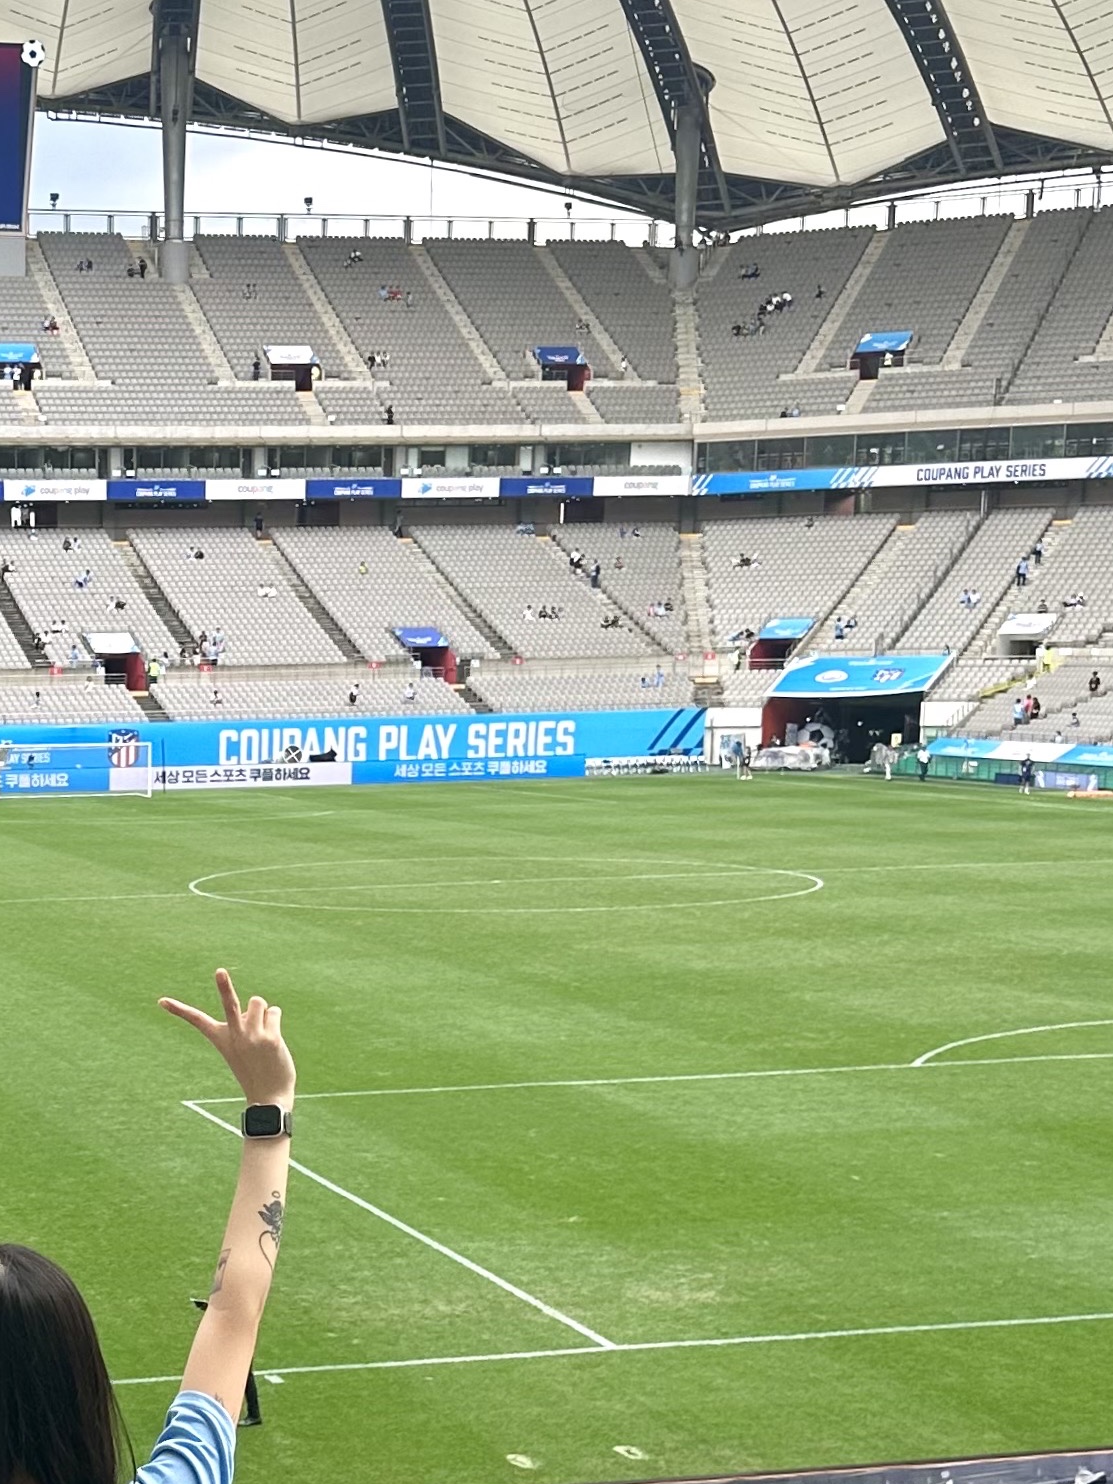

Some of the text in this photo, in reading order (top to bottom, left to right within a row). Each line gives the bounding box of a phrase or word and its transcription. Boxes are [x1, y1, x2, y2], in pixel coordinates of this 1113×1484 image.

[916, 463, 1046, 481] COUPANG PLAY SERIES
[74, 485, 90, 495] play
[219, 720, 576, 766] COUPANG PLAY SERIES
[182, 770, 208, 784] 모든
[209, 769, 247, 783] 스포츠
[249, 767, 311, 782] 쿠플하세요
[394, 764, 420, 778] 세상
[421, 763, 446, 777] 모든
[448, 762, 485, 777] 스포츠
